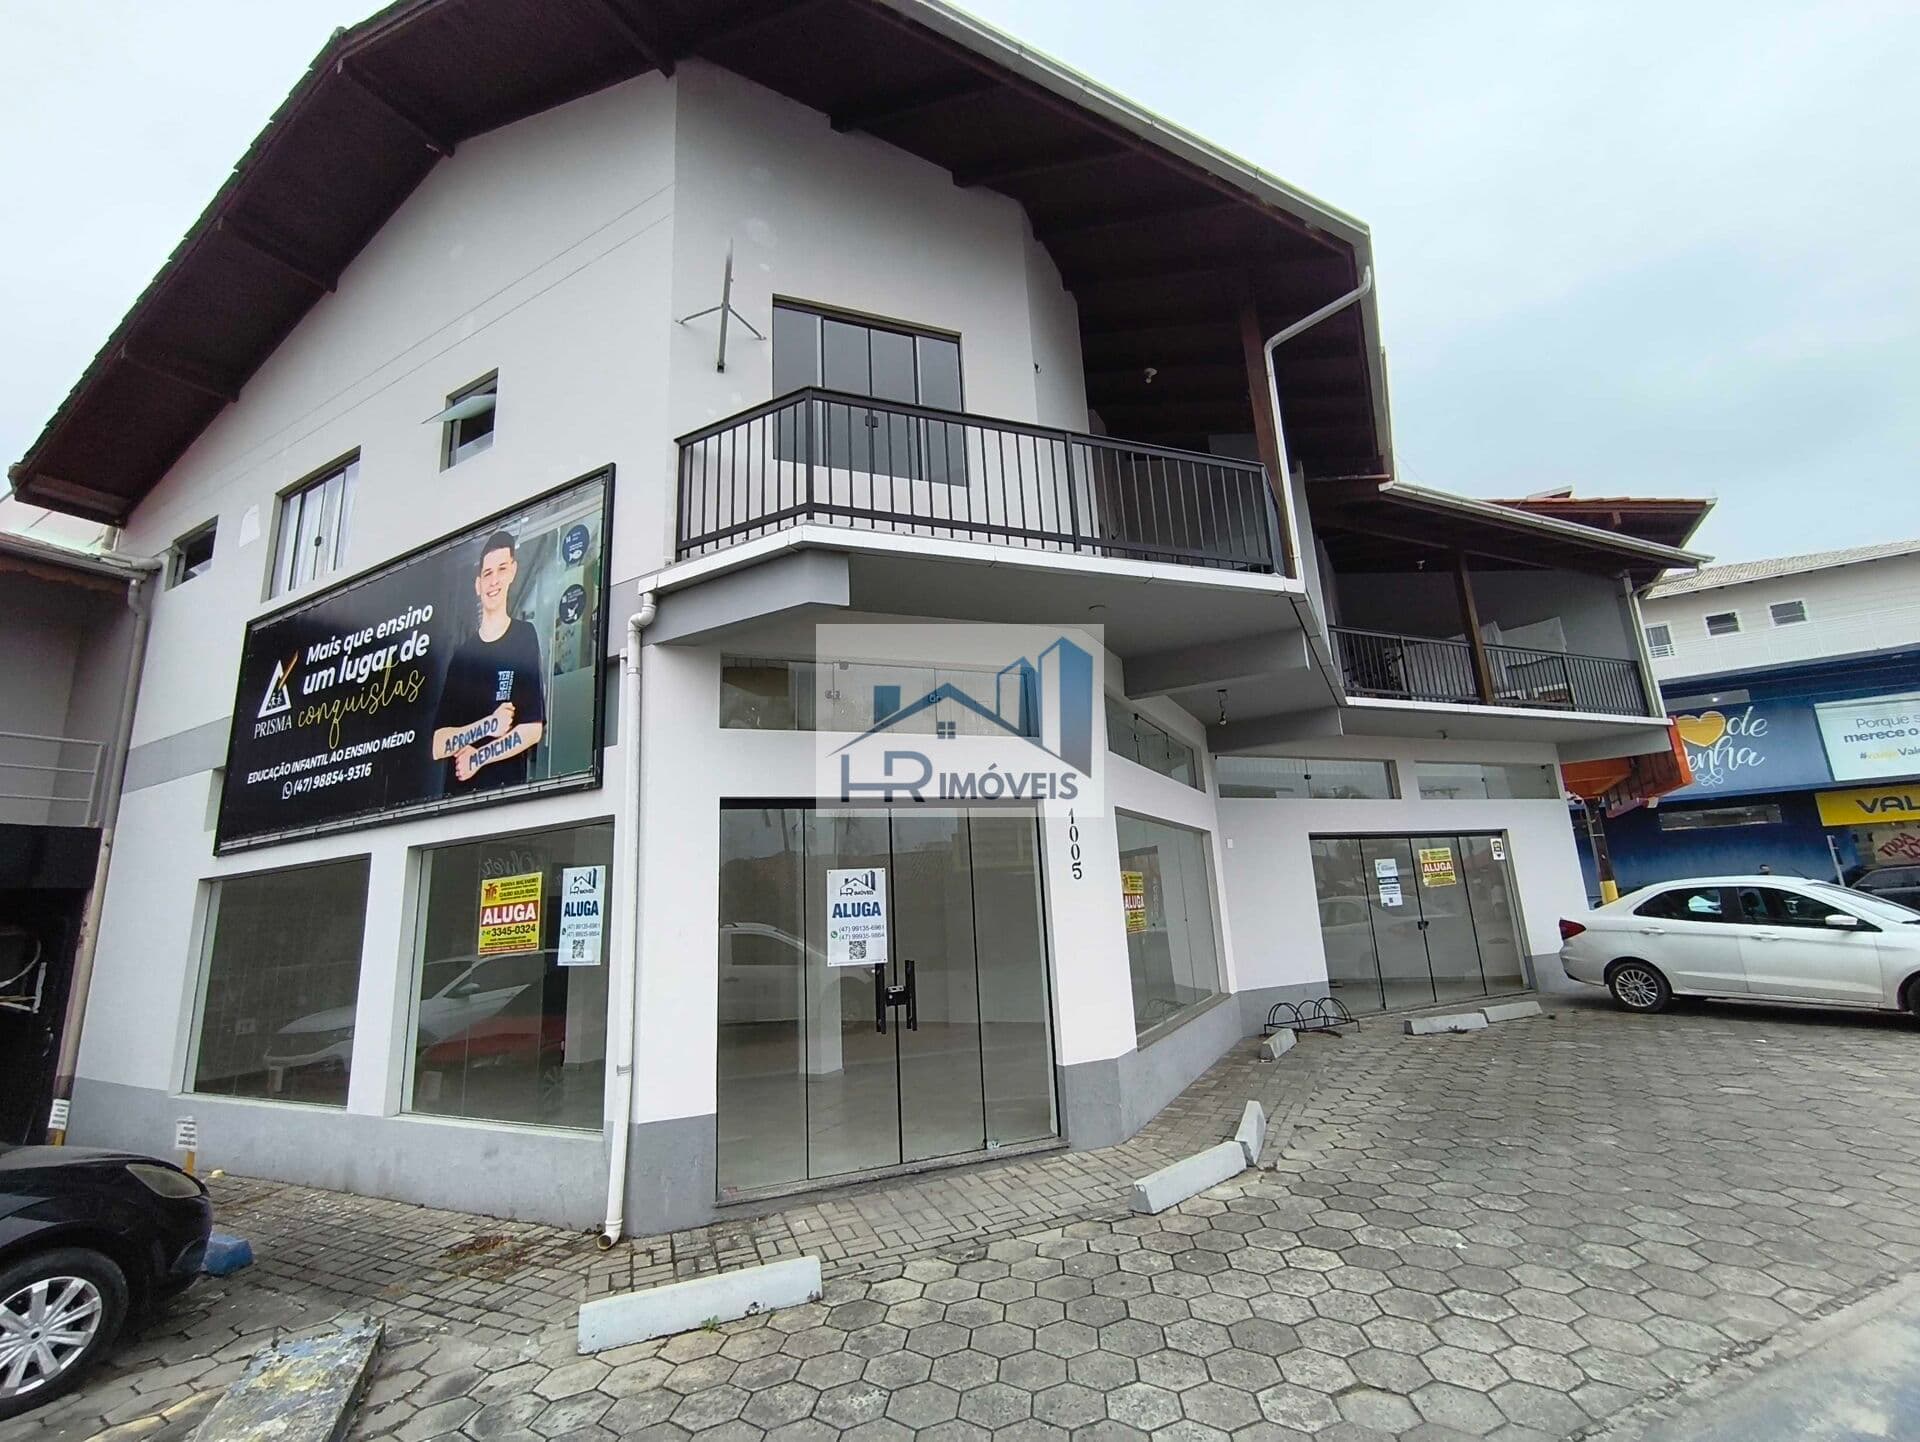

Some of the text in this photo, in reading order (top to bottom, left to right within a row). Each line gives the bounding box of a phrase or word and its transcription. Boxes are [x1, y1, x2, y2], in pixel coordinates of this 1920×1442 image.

[305, 604, 434, 665] Mais que ensino
[303, 630, 431, 696] um lugar de
[297, 656, 426, 750] conquistas
[253, 714, 292, 740] PRISMA
[443, 717, 499, 755] APROVADO
[1727, 705, 1769, 738] de
[1843, 728, 1905, 743] merece
[1855, 715, 1910, 728] Porque
[247, 728, 416, 785] EDUCAÇÃO INFANTIL AO ENSINO MÉDIO
[468, 731, 522, 771] MEDICINA
[1682, 735, 1766, 776] enha
[293, 762, 373, 796] (47) 98854-9316
[1068, 807, 1083, 880] 1005
[1423, 861, 1453, 873] ALUGA
[482, 901, 537, 926] ALUGA
[563, 900, 599, 918] ALUGA
[831, 901, 882, 919] ALUGA
[491, 923, 537, 938] 3345-0324
